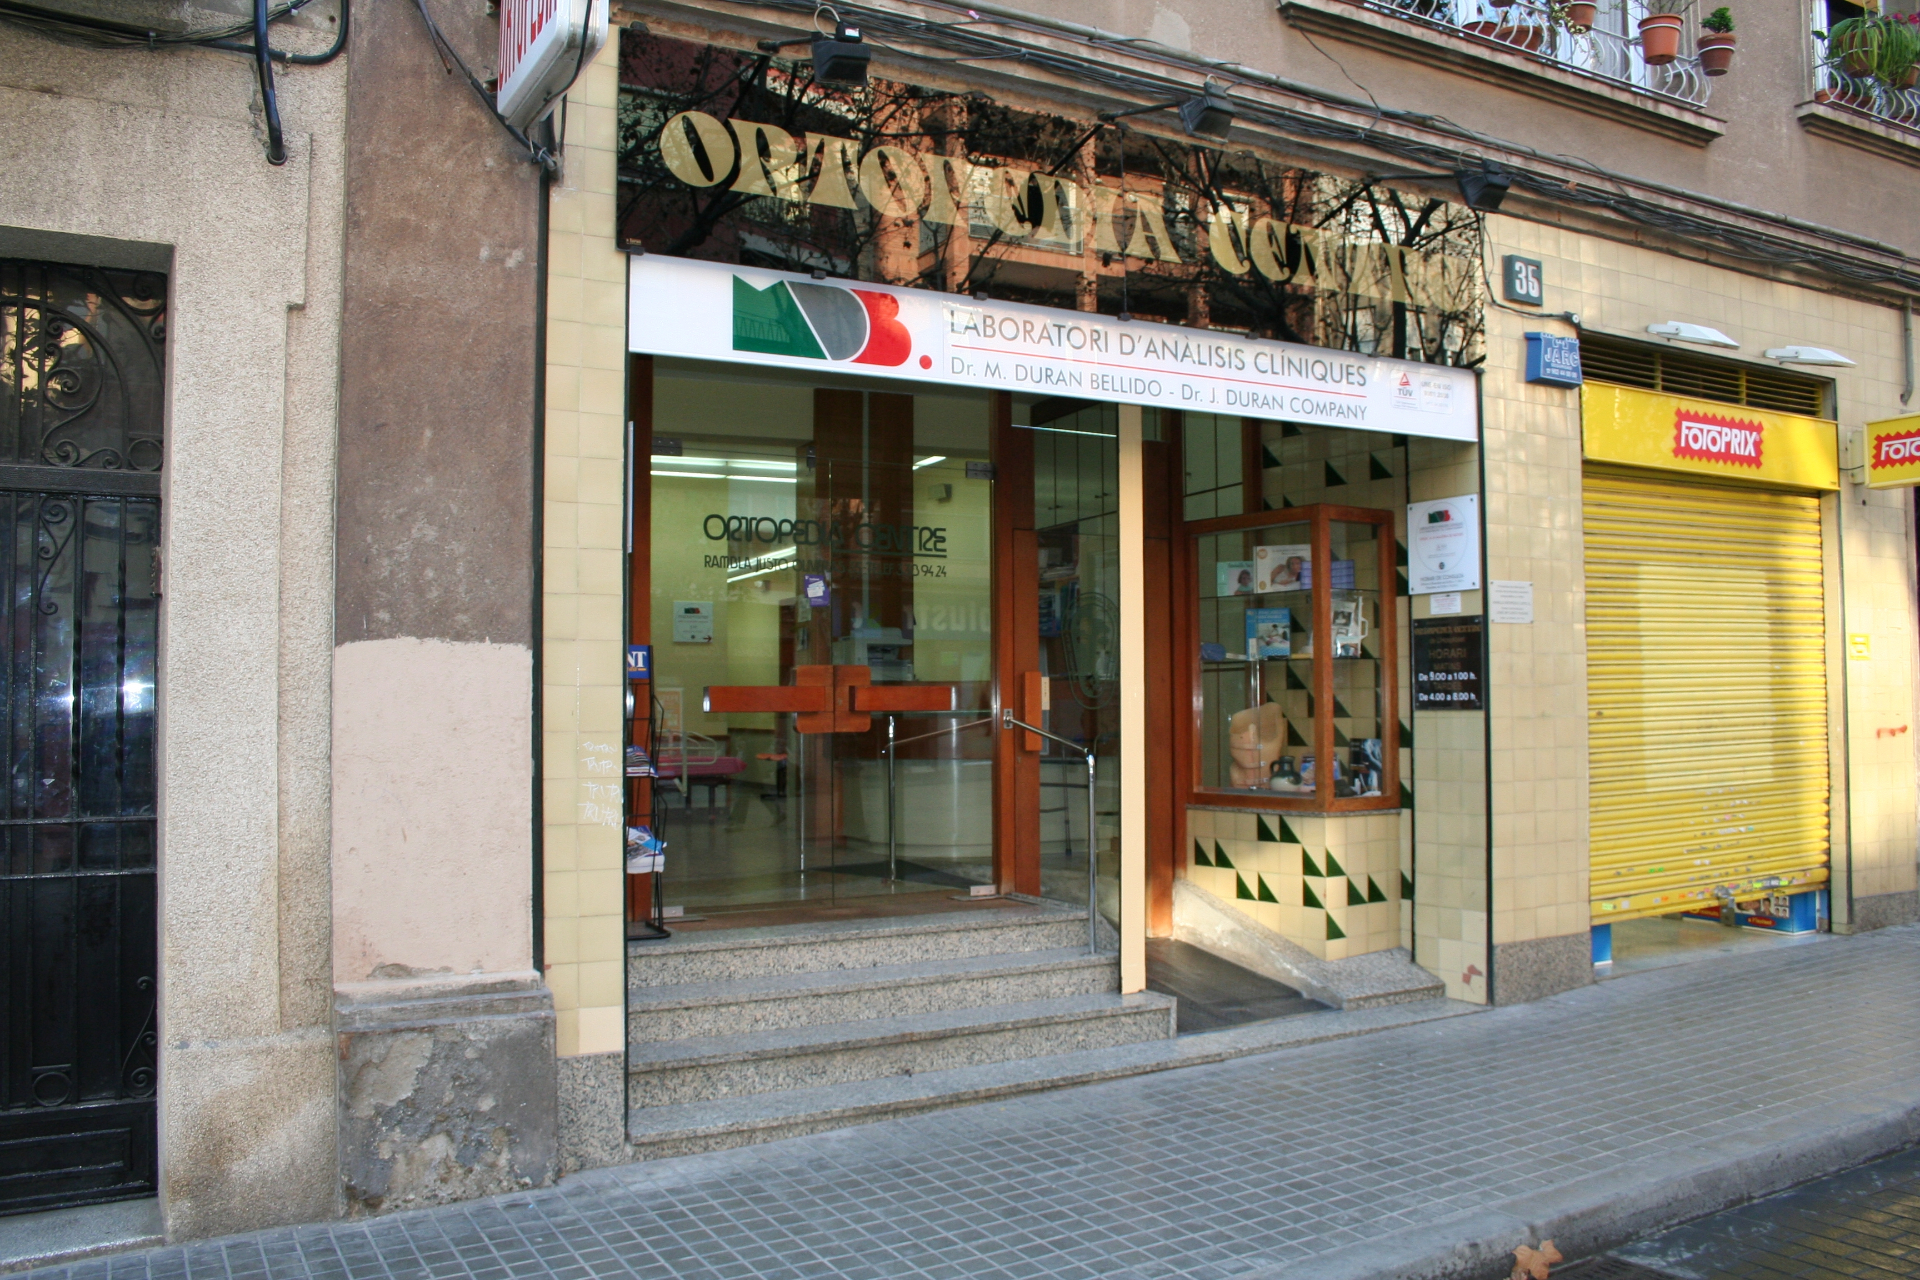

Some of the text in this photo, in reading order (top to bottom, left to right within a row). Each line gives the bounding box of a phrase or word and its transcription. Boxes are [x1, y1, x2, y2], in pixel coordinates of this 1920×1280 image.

[660, 110, 1183, 265] ORTOPEDIA
[1514, 261, 1540, 298] 35
[950, 309, 1368, 387] LABORATORI D'ANÀLISIS CLÍNIQUES
[951, 356, 977, 377] Dr.
[984, 360, 1007, 380] M.
[1015, 364, 1083, 388] DURAN
[1090, 373, 1162, 398] BELLIDO
[1181, 384, 1203, 403] Dr.
[1209, 387, 1220, 404] J.
[1226, 389, 1284, 411] DURAN
[1289, 397, 1368, 421] COMPANY
[1397, 386, 1414, 397] TÜV
[1680, 420, 1757, 457] FOTOPRIX
[703, 513, 947, 552] ORTOPEDIA CENTRE
[704, 554, 752, 569] RAMBLA
[755, 556, 790, 573] JUSTO
[1428, 647, 1468, 659] HORARI
[1418, 672, 1429, 681] De
[1447, 673, 1453, 681] a
[1418, 692, 1429, 702] De
[1446, 693, 1452, 701] a
